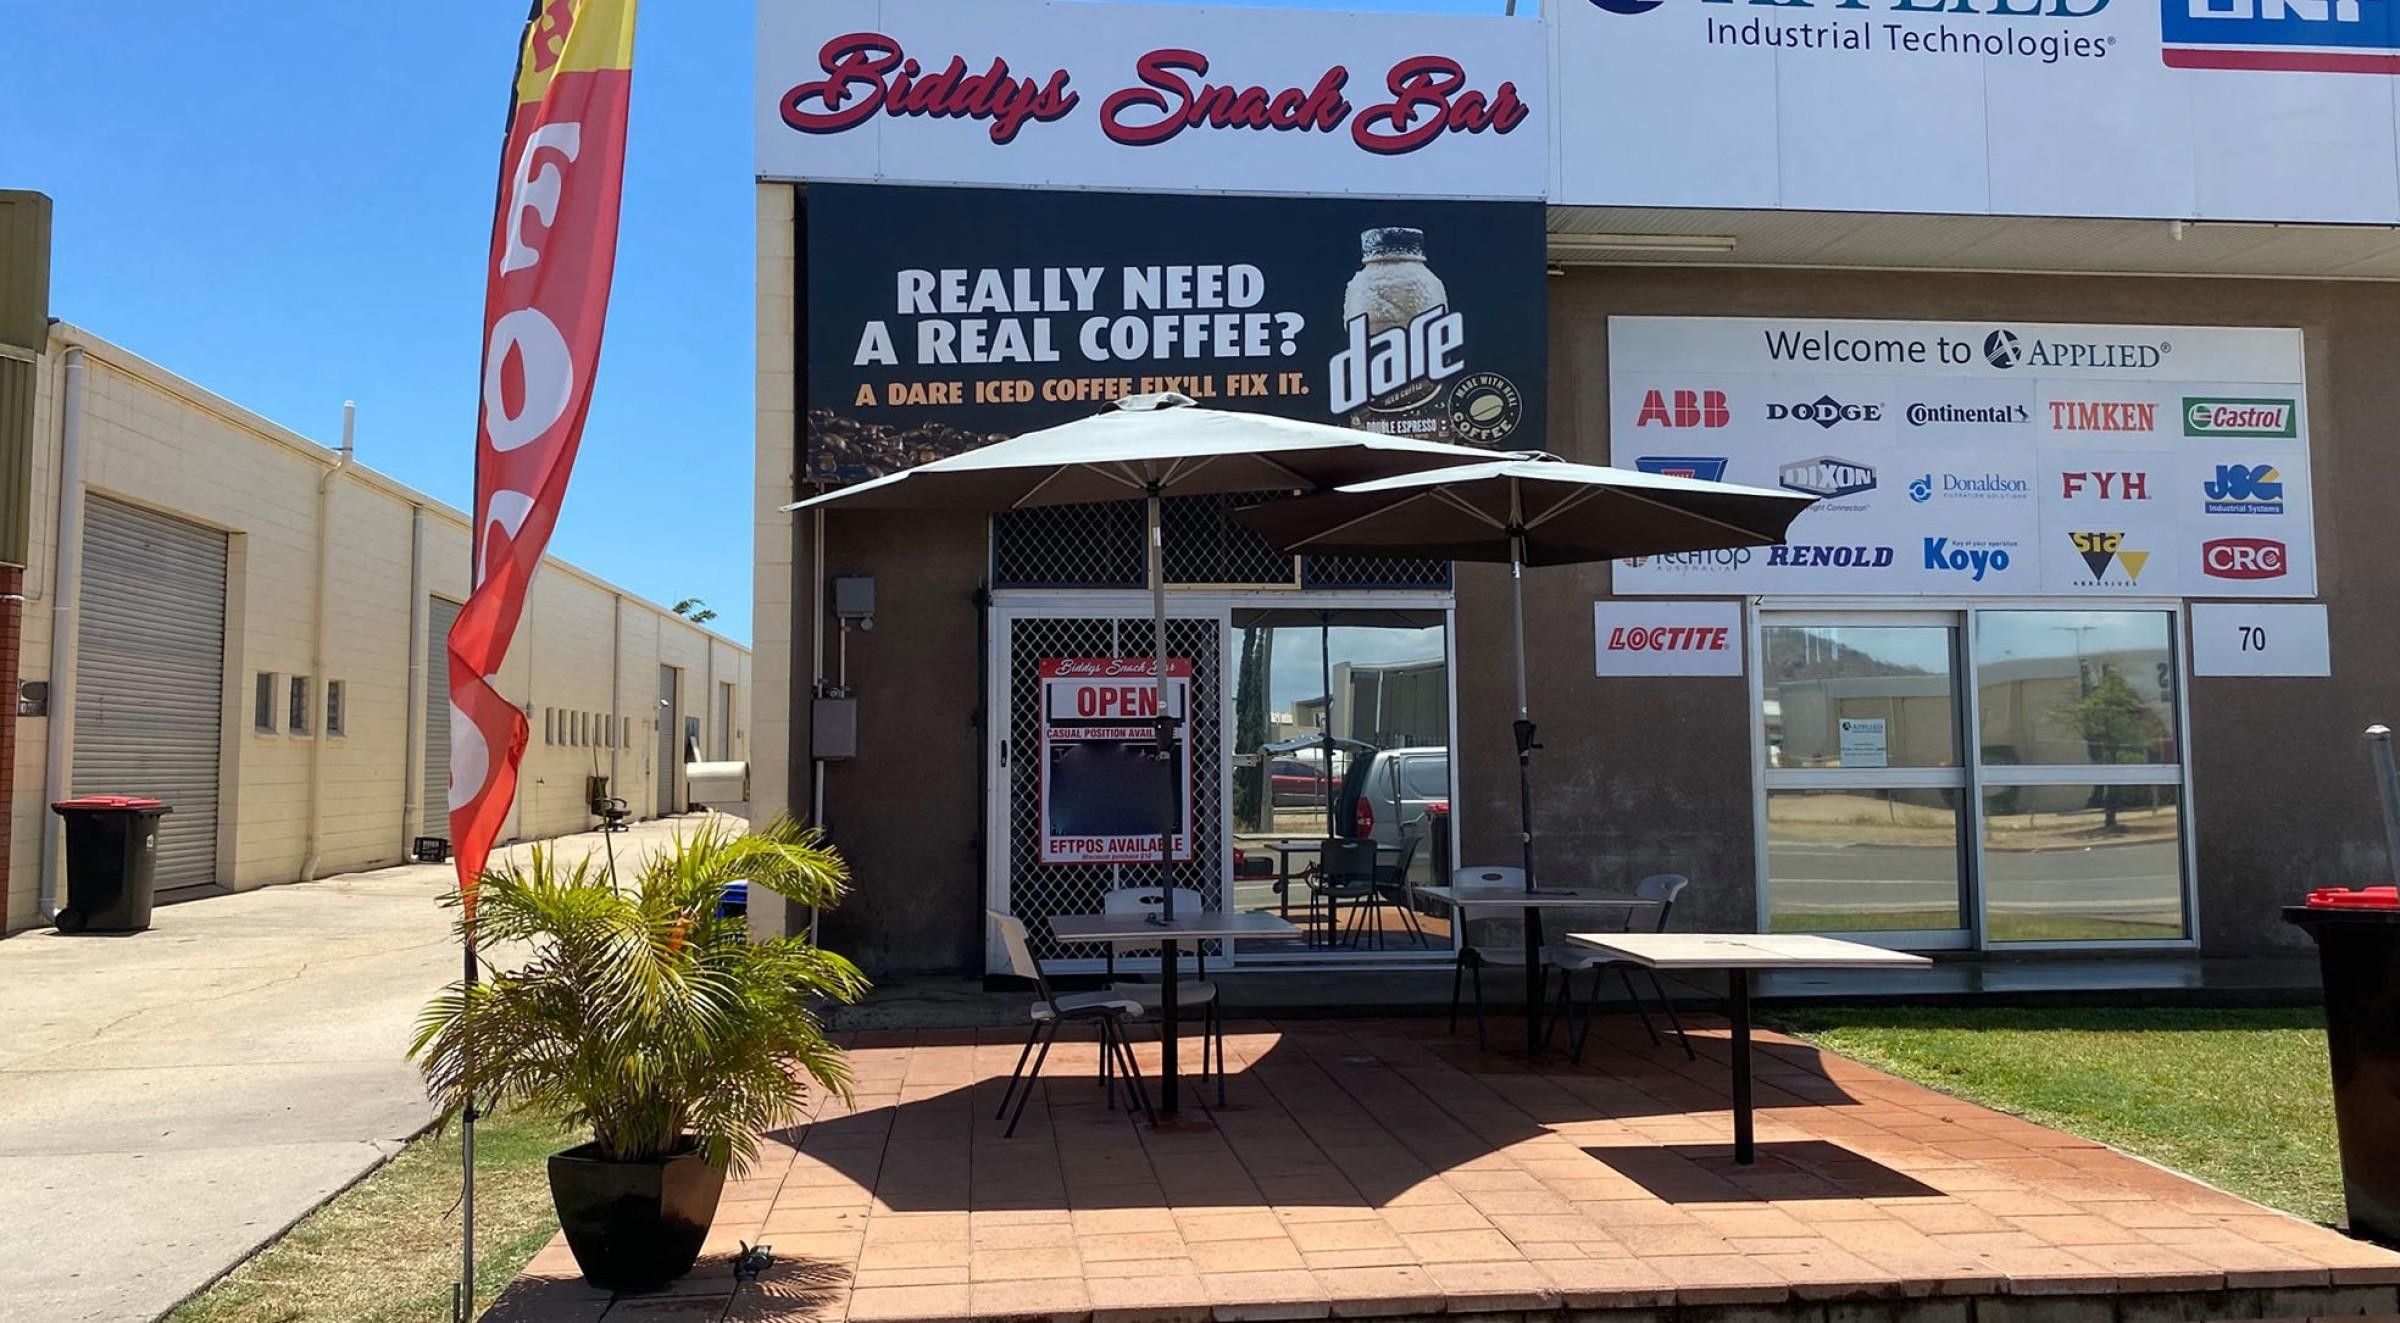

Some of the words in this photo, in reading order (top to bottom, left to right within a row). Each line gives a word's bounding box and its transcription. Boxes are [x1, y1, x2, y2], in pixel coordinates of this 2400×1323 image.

[1706, 17, 1870, 49] Industrial
[779, 32, 1080, 145] Biddys
[1100, 49, 1353, 146] Snack
[1351, 55, 1530, 155] Bar
[896, 266, 1105, 314] REALLY
[1123, 263, 1265, 310] NEED
[853, 320, 899, 366] A
[917, 317, 1061, 365] REAL
[1079, 311, 1306, 362] COFFEE?
[1765, 330, 1927, 364] Welcome
[1937, 336, 1972, 364] to
[1329, 303, 1465, 415] dare
[855, 383, 878, 407] A
[888, 381, 963, 406] DARE
[975, 379, 1035, 404] ICED
[1042, 376, 1133, 401] COFFEE
[1227, 373, 1269, 397] FIX
[1279, 372, 1311, 395] IT.
[1455, 377, 1479, 399] MADE
[1480, 375, 1505, 390] WITH
[1636, 389, 1731, 428] ABB
[1766, 403, 1882, 422] DODGE
[1906, 402, 2012, 427] Continental
[2049, 400, 2156, 431] TIMKEN
[2213, 406, 2282, 429] Castrol
[1397, 417, 1438, 434] ESPRESSO
[1453, 411, 1513, 440] COFFEE
[1784, 463, 1872, 489] DIXON
[1943, 473, 2027, 492] Donaldson
[2062, 471, 2148, 500] FYH
[2208, 503, 2247, 513] Industrial
[2248, 504, 2281, 516] Systems
[1766, 545, 1894, 568] RENOLD
[1924, 537, 2010, 582] Koyo
[2207, 545, 2282, 572] CRC
[1607, 626, 1729, 651] LOCTITE
[2238, 626, 2266, 652] 70
[1055, 659, 1102, 676] Biddys
[1105, 659, 1146, 676] Snack
[1077, 686, 1158, 718] OPEN
[1046, 728, 1081, 739] CASUAL
[1084, 728, 1127, 739] POSITION
[1050, 838, 1104, 854] EFTPOS
